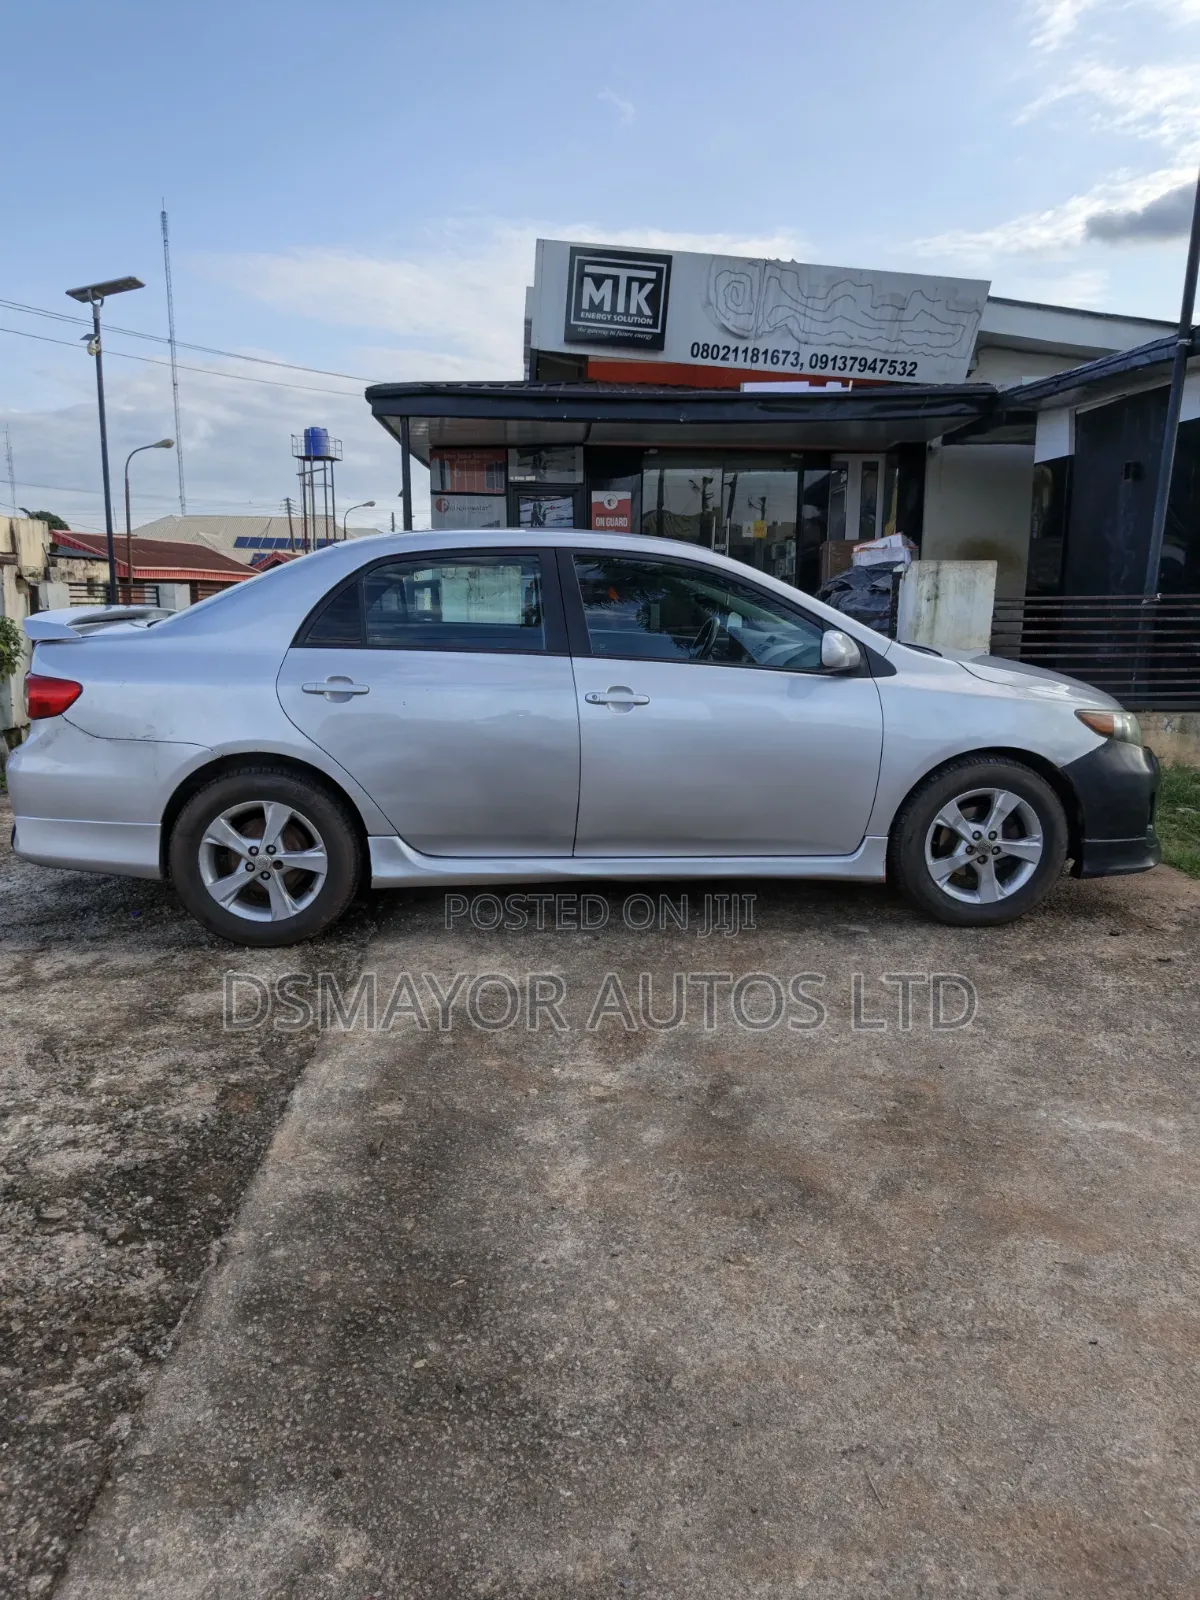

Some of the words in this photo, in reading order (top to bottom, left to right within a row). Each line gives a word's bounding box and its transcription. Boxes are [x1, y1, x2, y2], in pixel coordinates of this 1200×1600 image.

[581, 265, 657, 316] MTK
[580, 312, 612, 321] ENERGY
[613, 314, 653, 325] SOLUTION
[690, 341, 804, 371] 08021181673,
[808, 353, 918, 377] 09137947532
[595, 516, 605, 527] ON
[606, 516, 628, 527] GUARD
